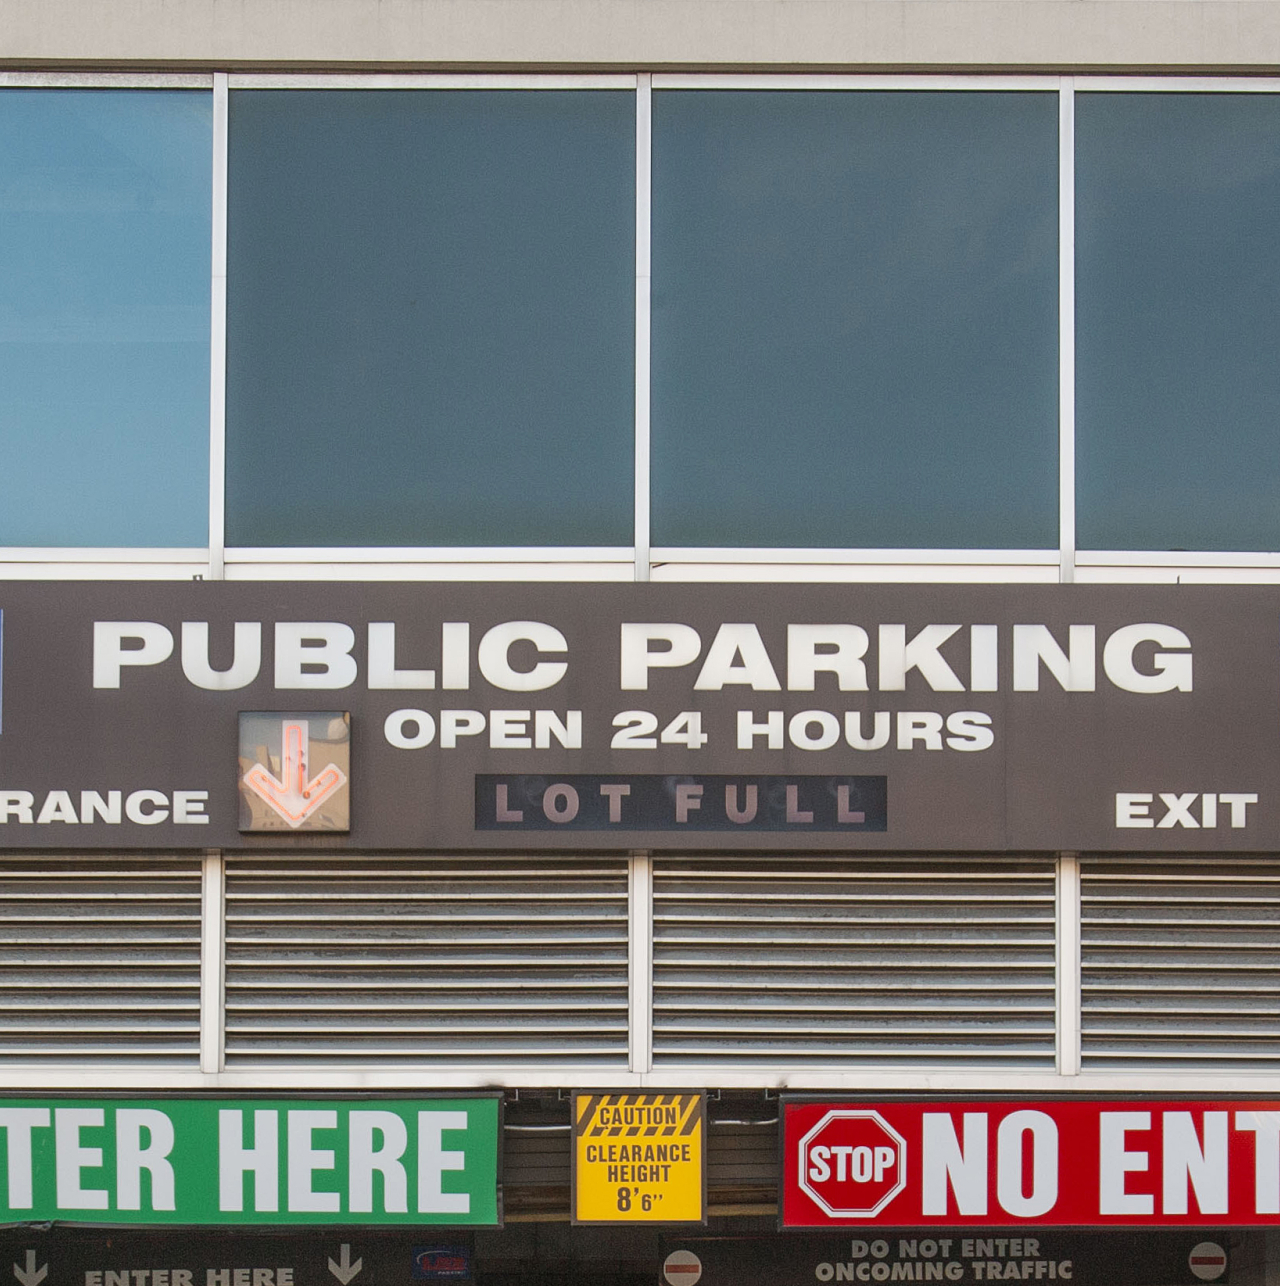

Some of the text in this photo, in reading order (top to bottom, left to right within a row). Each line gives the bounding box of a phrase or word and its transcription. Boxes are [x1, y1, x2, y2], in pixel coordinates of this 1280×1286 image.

[92, 620, 1195, 694] PUBLIC PARKING
[384, 708, 996, 753] OPEN 24 HOURS
[494, 783, 867, 824] LOT FULL
[1115, 792, 1259, 830] EXIT
[600, 1107, 677, 1126] CAUTION
[217, 1109, 471, 1214] HERE
[586, 1144, 691, 1163] CLEARANCE
[809, 1144, 896, 1184] STOP
[921, 1110, 1060, 1218] NO
[607, 1164, 672, 1183] HEIGHT
[851, 1238, 1041, 1259] DO NOT ENTER
[814, 1260, 1074, 1283] ONCOMING TRAFFIC
